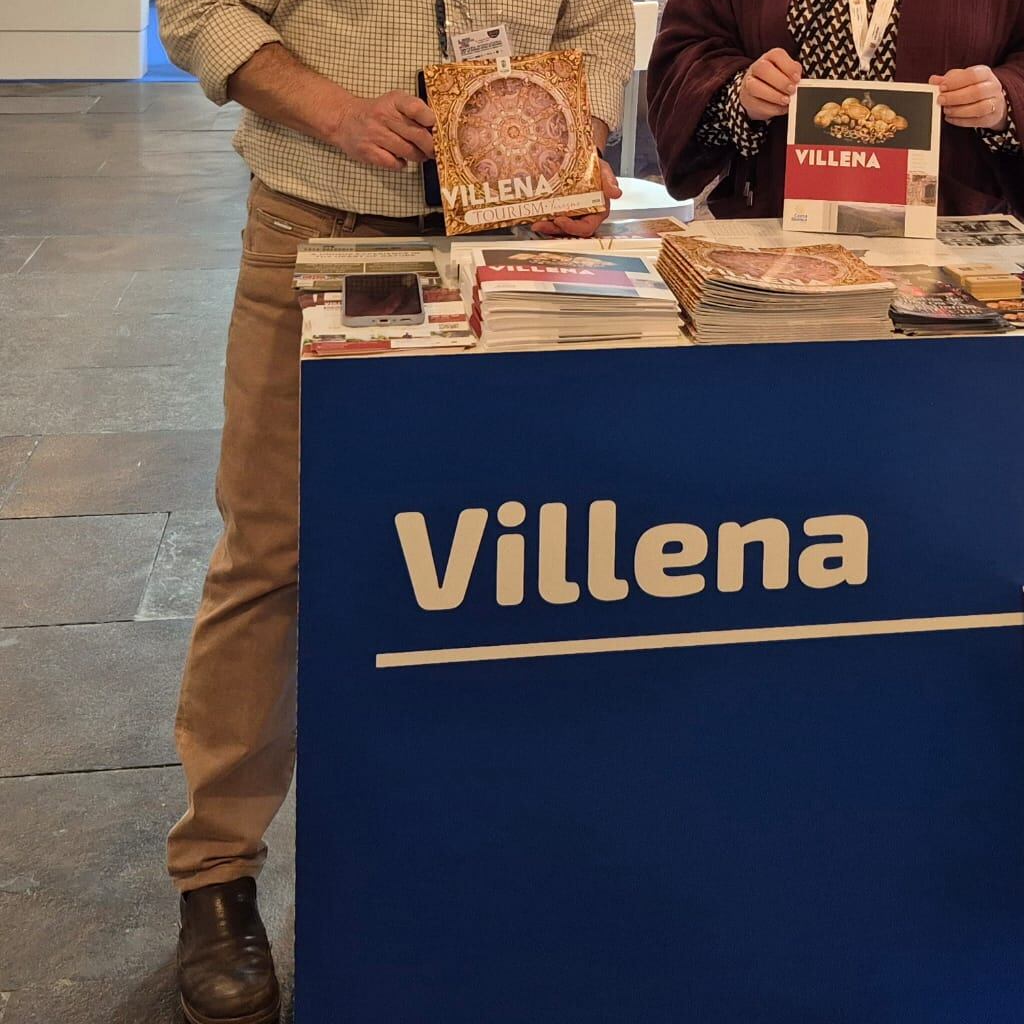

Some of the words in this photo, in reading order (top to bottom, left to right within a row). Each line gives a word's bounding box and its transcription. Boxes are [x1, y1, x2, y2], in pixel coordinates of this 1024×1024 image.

[795, 149, 880, 169] VILLENA
[441, 173, 555, 209] VILLENA
[474, 201, 545, 224] TOURISM
[489, 265, 595, 276] VILLENA
[394, 499, 869, 611] Villena
